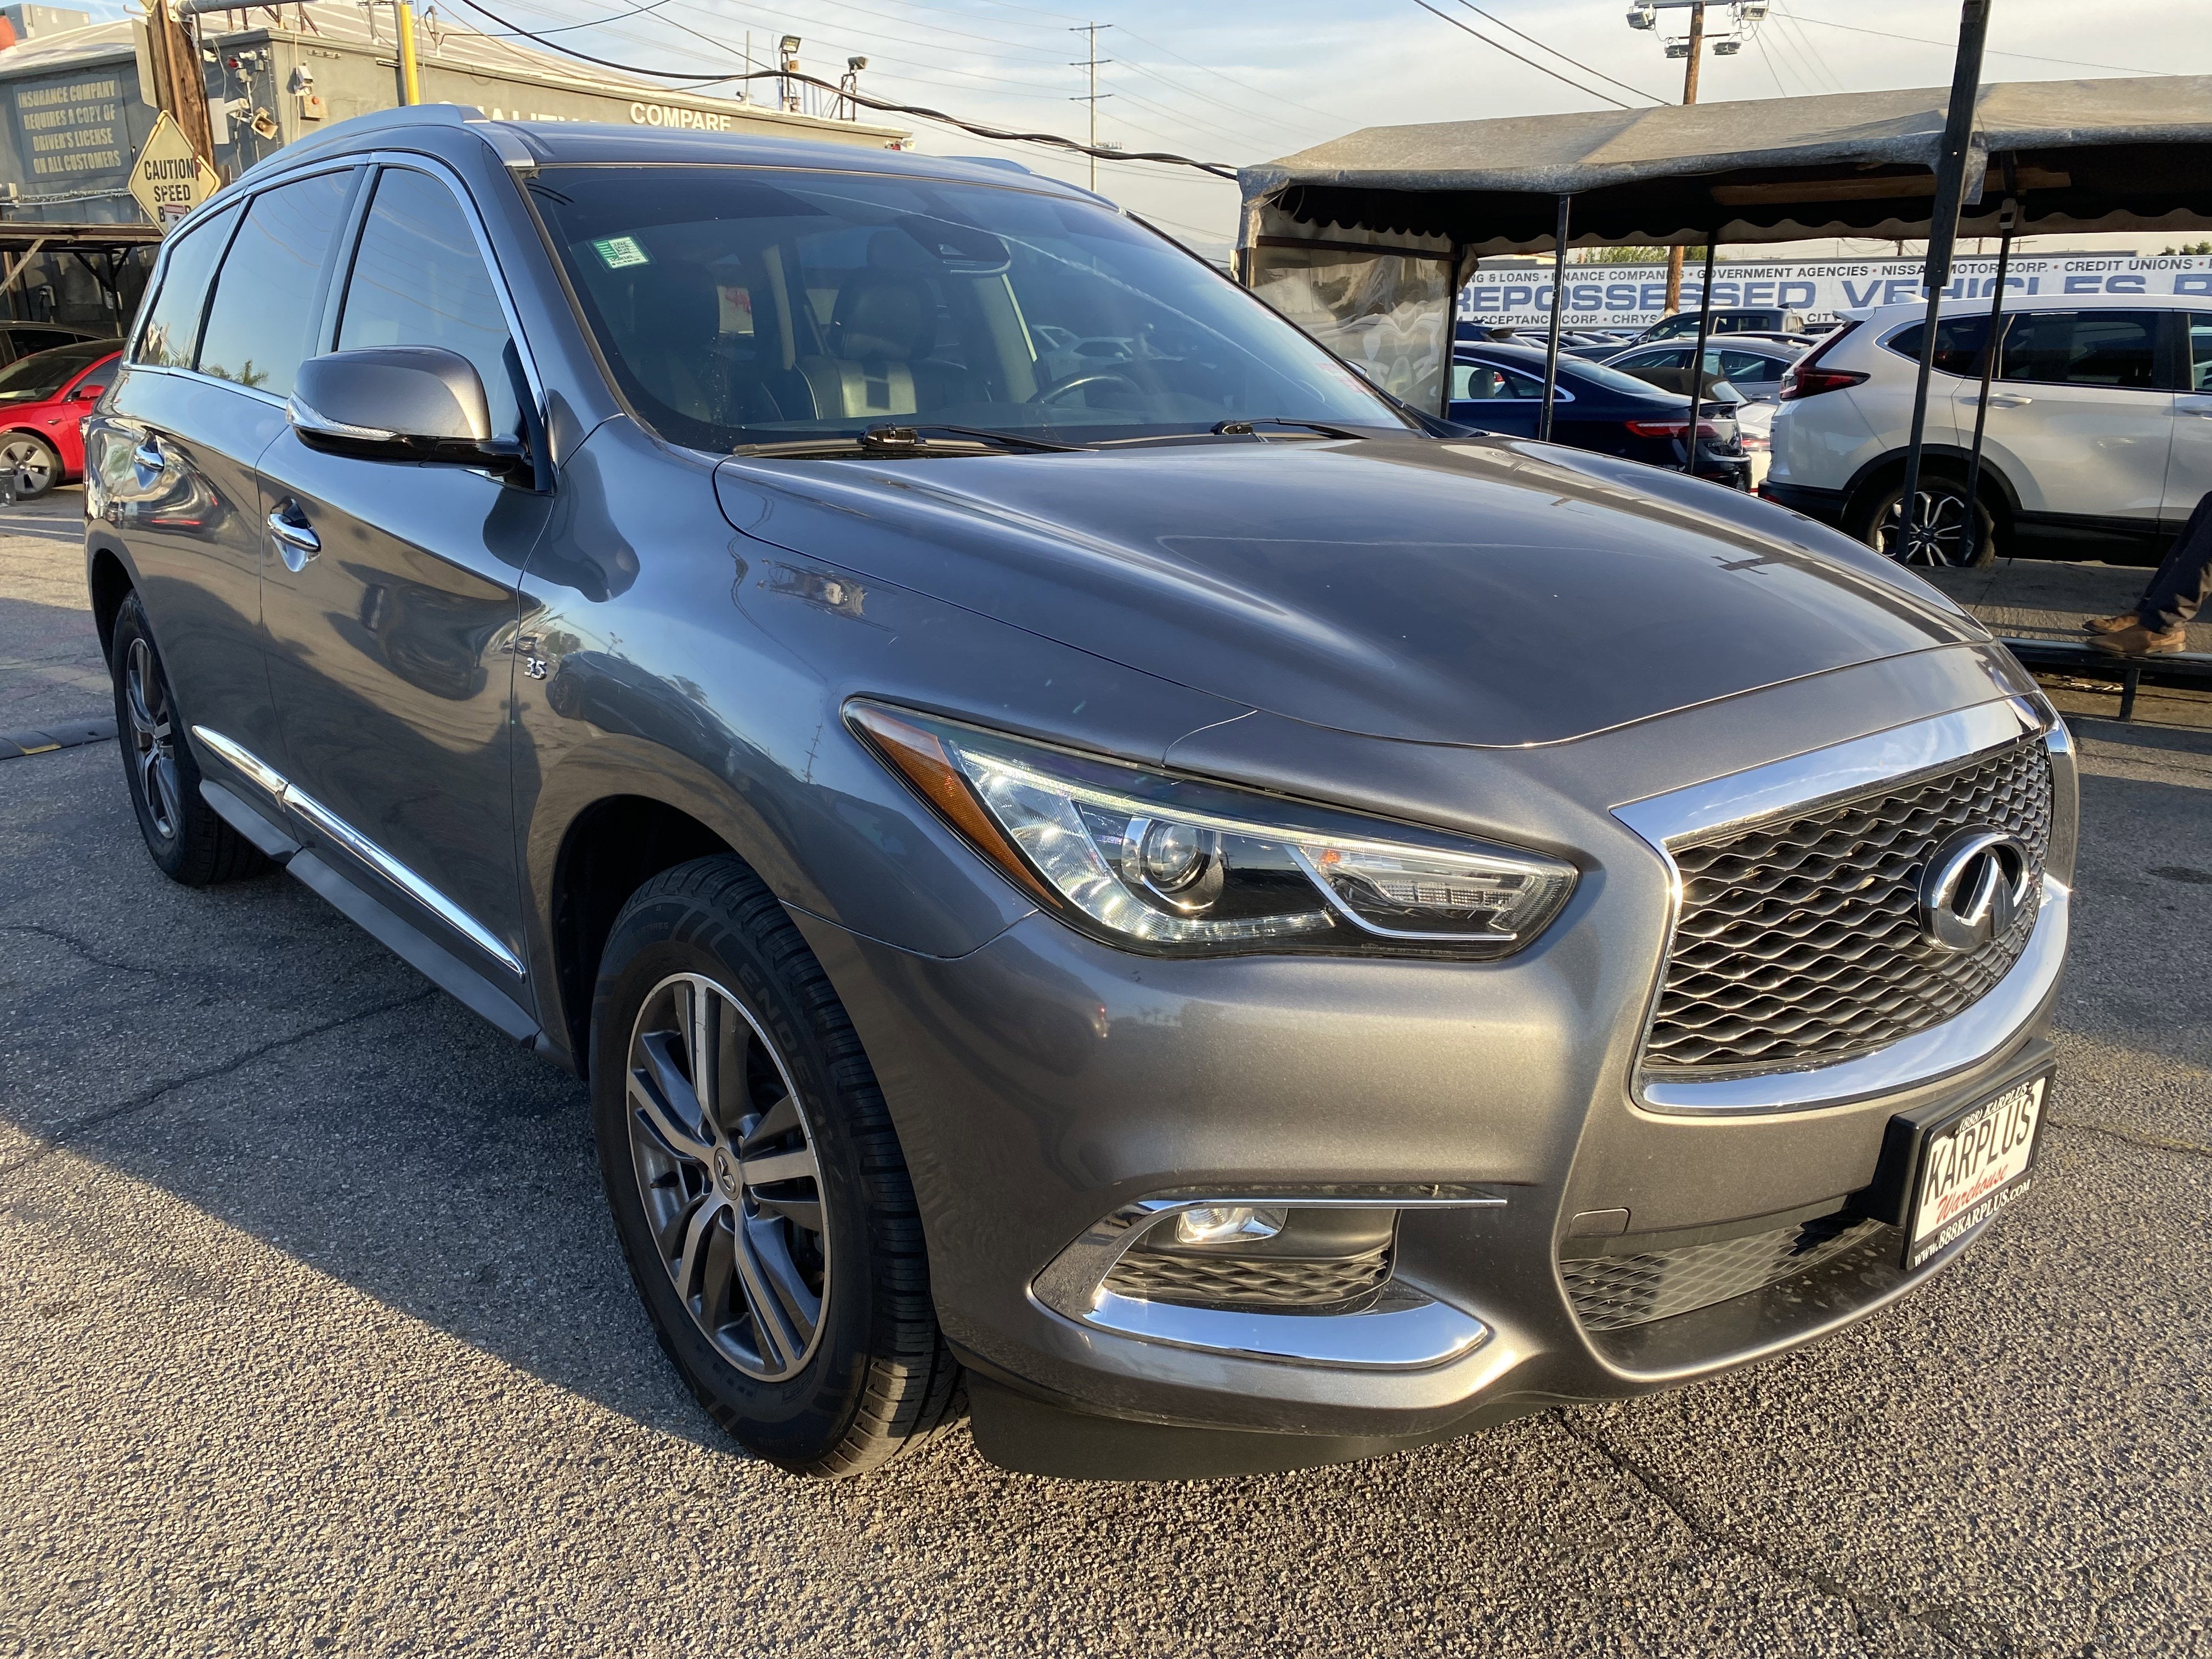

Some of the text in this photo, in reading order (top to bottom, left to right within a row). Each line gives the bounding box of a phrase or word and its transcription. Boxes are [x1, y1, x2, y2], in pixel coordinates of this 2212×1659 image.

[18, 80, 115, 108] INSURANCE COMPANY
[24, 104, 115, 130] REQUIRES A COPY OF
[33, 127, 114, 151] DRIVER'S LICENSE
[33, 150, 121, 174] ON ALL CUSTOMERS
[144, 158, 194, 180] CAUTION
[154, 184, 190, 202] SPEED
[1499, 272, 1539, 283] LOANS
[1697, 268, 1793, 279] GVERNMENT
[1797, 266, 1869, 277] AGENCIES
[1881, 264, 1926, 275] NISSA
[2065, 261, 2123, 272] CREDIT
[2129, 259, 2193, 270] UNIONS
[1458, 281, 1816, 312] REPOSSESSED
[1562, 314, 1598, 324] CORP.
[1959, 1081, 2030, 1132] (888) KARPLUS
[1923, 1093, 2034, 1206] KARPLUS
[1936, 1164, 2008, 1224] Warehouse
